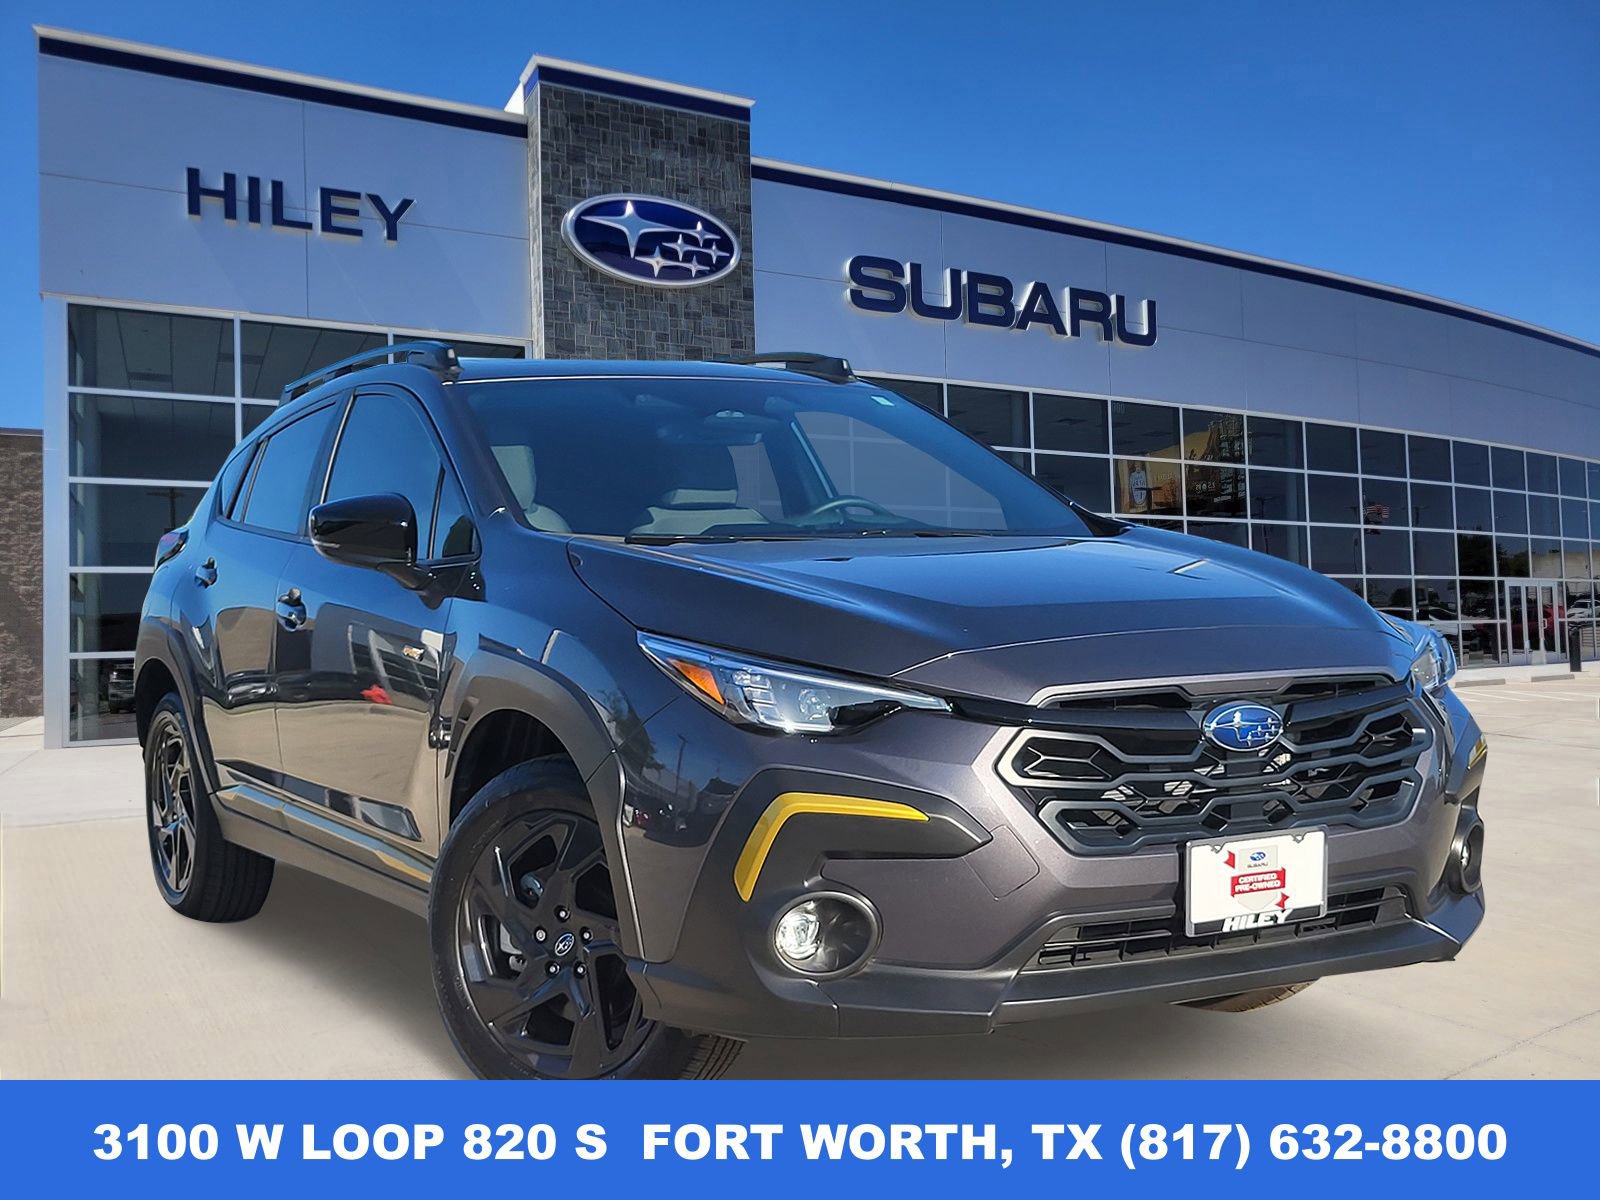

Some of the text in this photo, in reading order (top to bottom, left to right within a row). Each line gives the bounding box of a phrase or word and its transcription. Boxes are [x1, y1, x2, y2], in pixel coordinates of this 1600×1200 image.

[187, 166, 415, 242] HILEY
[845, 254, 1158, 347] SUBARU
[1234, 879, 1281, 893] PRE-OWNED
[1238, 872, 1278, 885] CERTIFIED
[1222, 909, 1293, 932] HILEY
